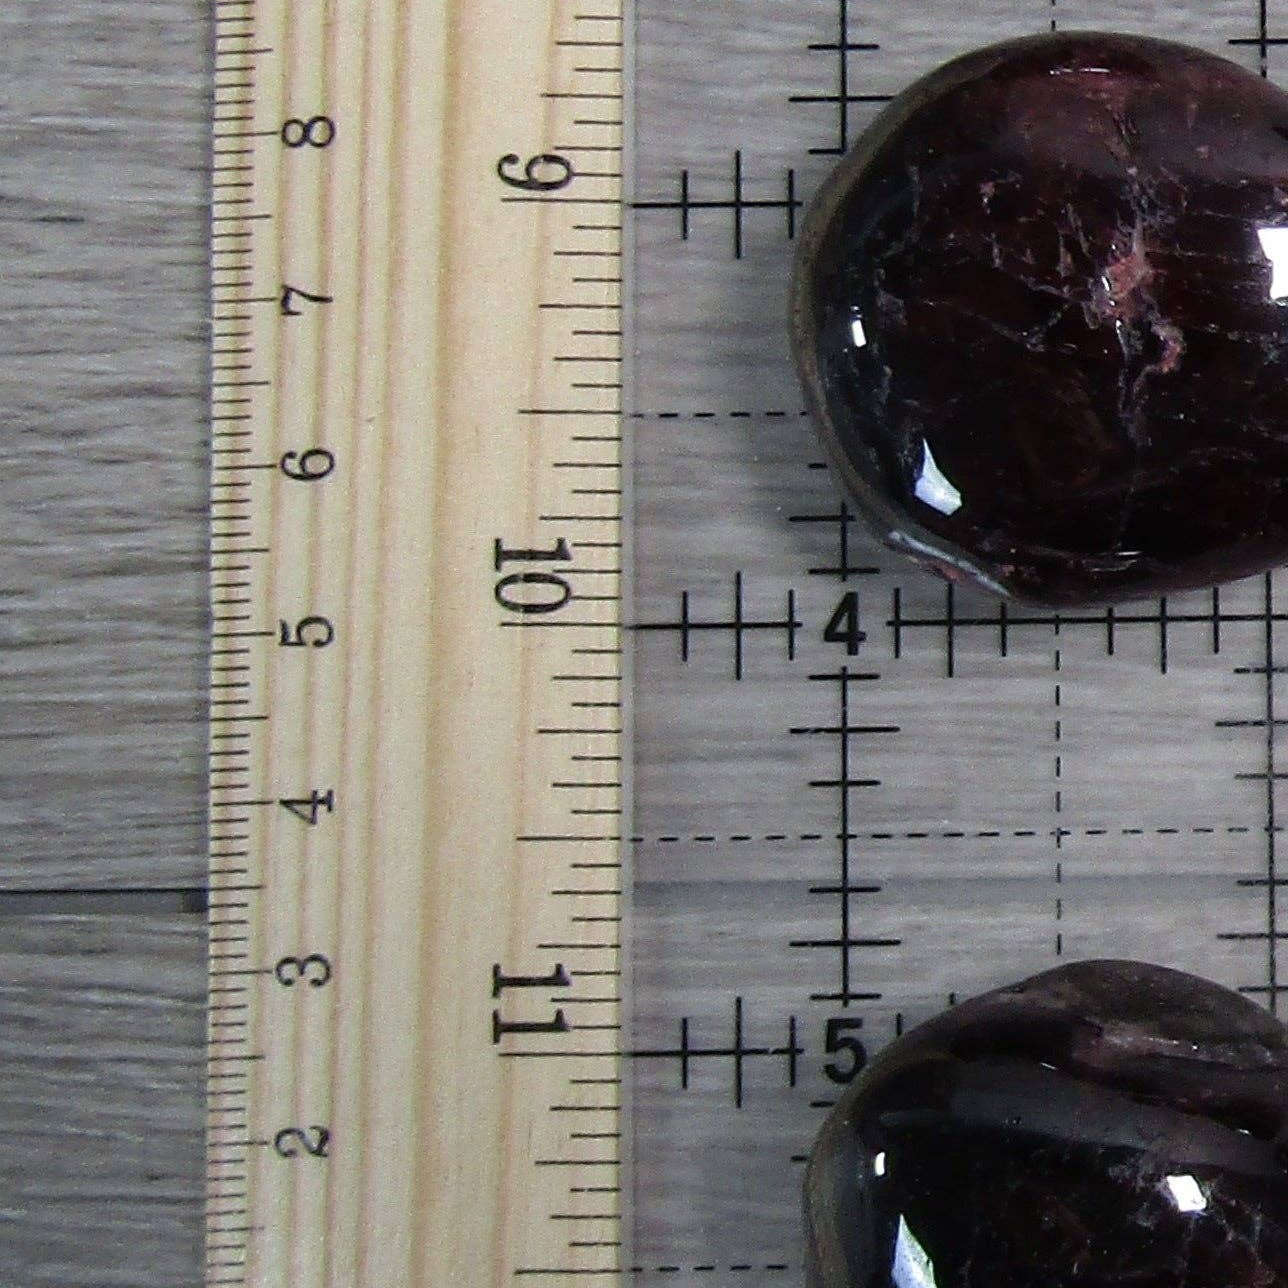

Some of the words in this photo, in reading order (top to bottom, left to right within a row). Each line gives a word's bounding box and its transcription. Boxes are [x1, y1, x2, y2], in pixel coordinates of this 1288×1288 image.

[282, 116, 335, 149] 8
[497, 152, 573, 193] 9
[281, 285, 332, 316] 7
[281, 449, 335, 482] 6
[493, 537, 574, 616] 10
[281, 617, 333, 648] 5
[823, 591, 867, 657] 4
[280, 788, 334, 824] 4
[275, 952, 332, 989] 3
[492, 963, 573, 1044] 11
[824, 1017, 867, 1085] 5
[275, 1124, 330, 1158] 2
